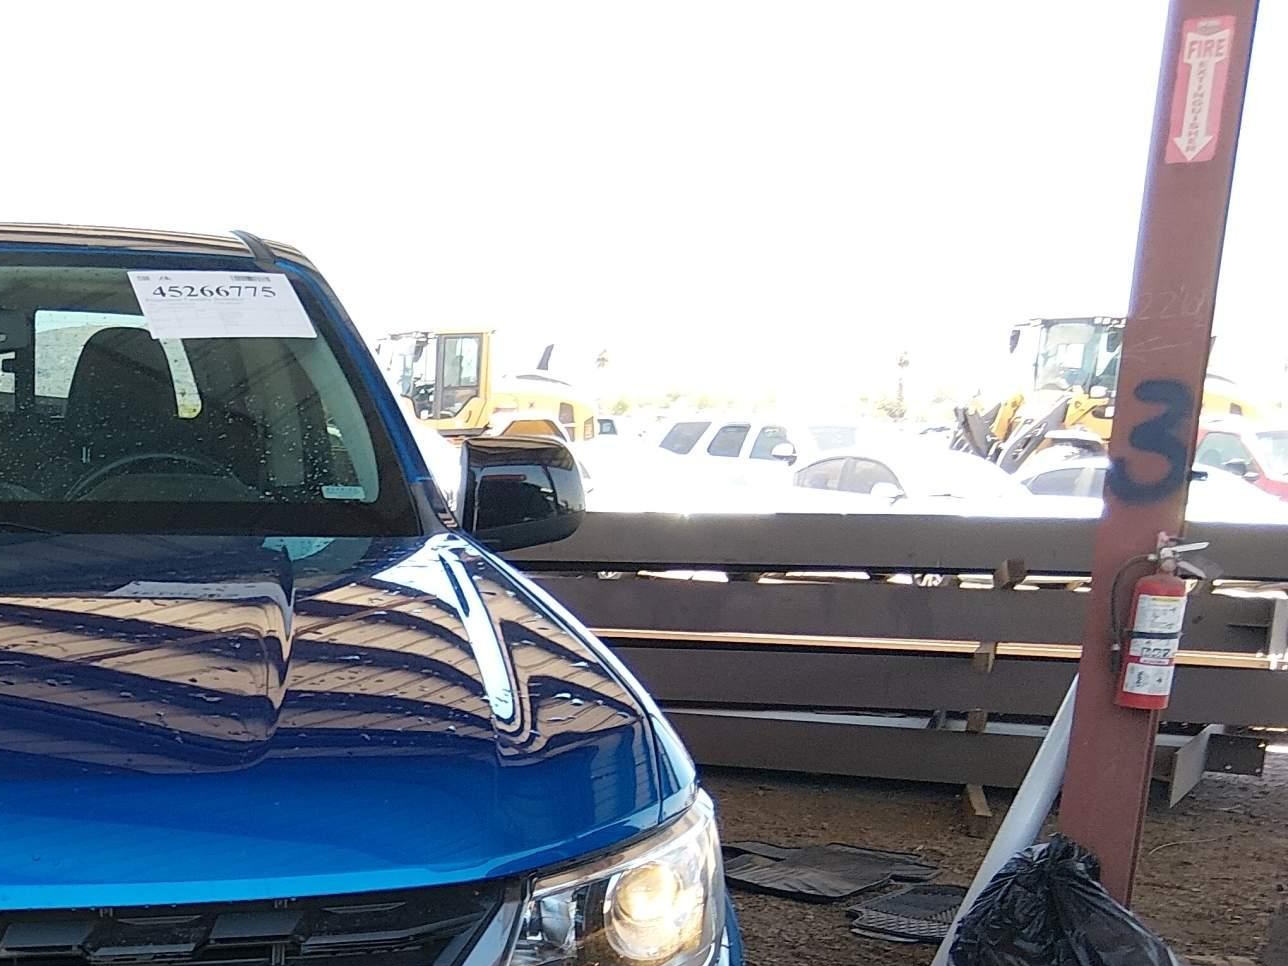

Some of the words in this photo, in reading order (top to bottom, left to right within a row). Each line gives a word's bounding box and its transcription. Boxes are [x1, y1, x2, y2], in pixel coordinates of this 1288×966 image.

[1186, 37, 1227, 60] FIRE
[152, 284, 277, 298] 45266775
[1108, 380, 1193, 505] 3
